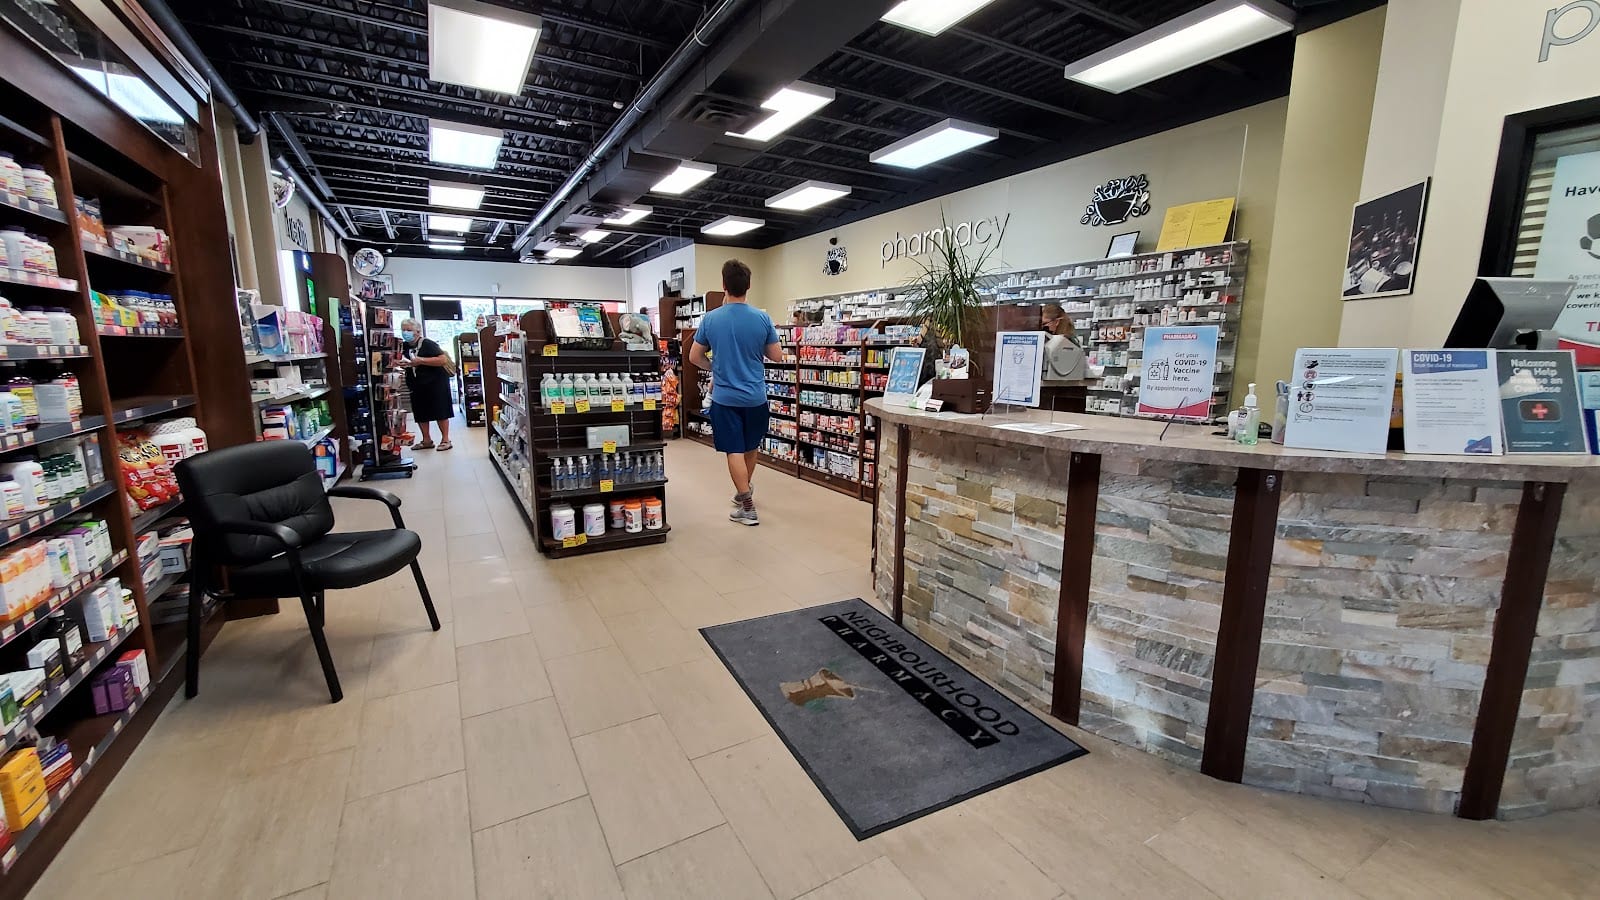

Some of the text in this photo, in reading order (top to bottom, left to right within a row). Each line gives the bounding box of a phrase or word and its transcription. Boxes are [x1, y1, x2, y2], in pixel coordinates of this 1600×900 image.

[1565, 185, 1600, 197] Hav
[881, 213, 1010, 269] pharmacy
[1413, 353, 1452, 362] COVID-19
[1510, 359, 1557, 367] Naloxone
[1533, 367, 1558, 377] Help
[823, 616, 990, 742] PHARMACY
[841, 610, 1020, 736] NEIGHBOURHOOD
